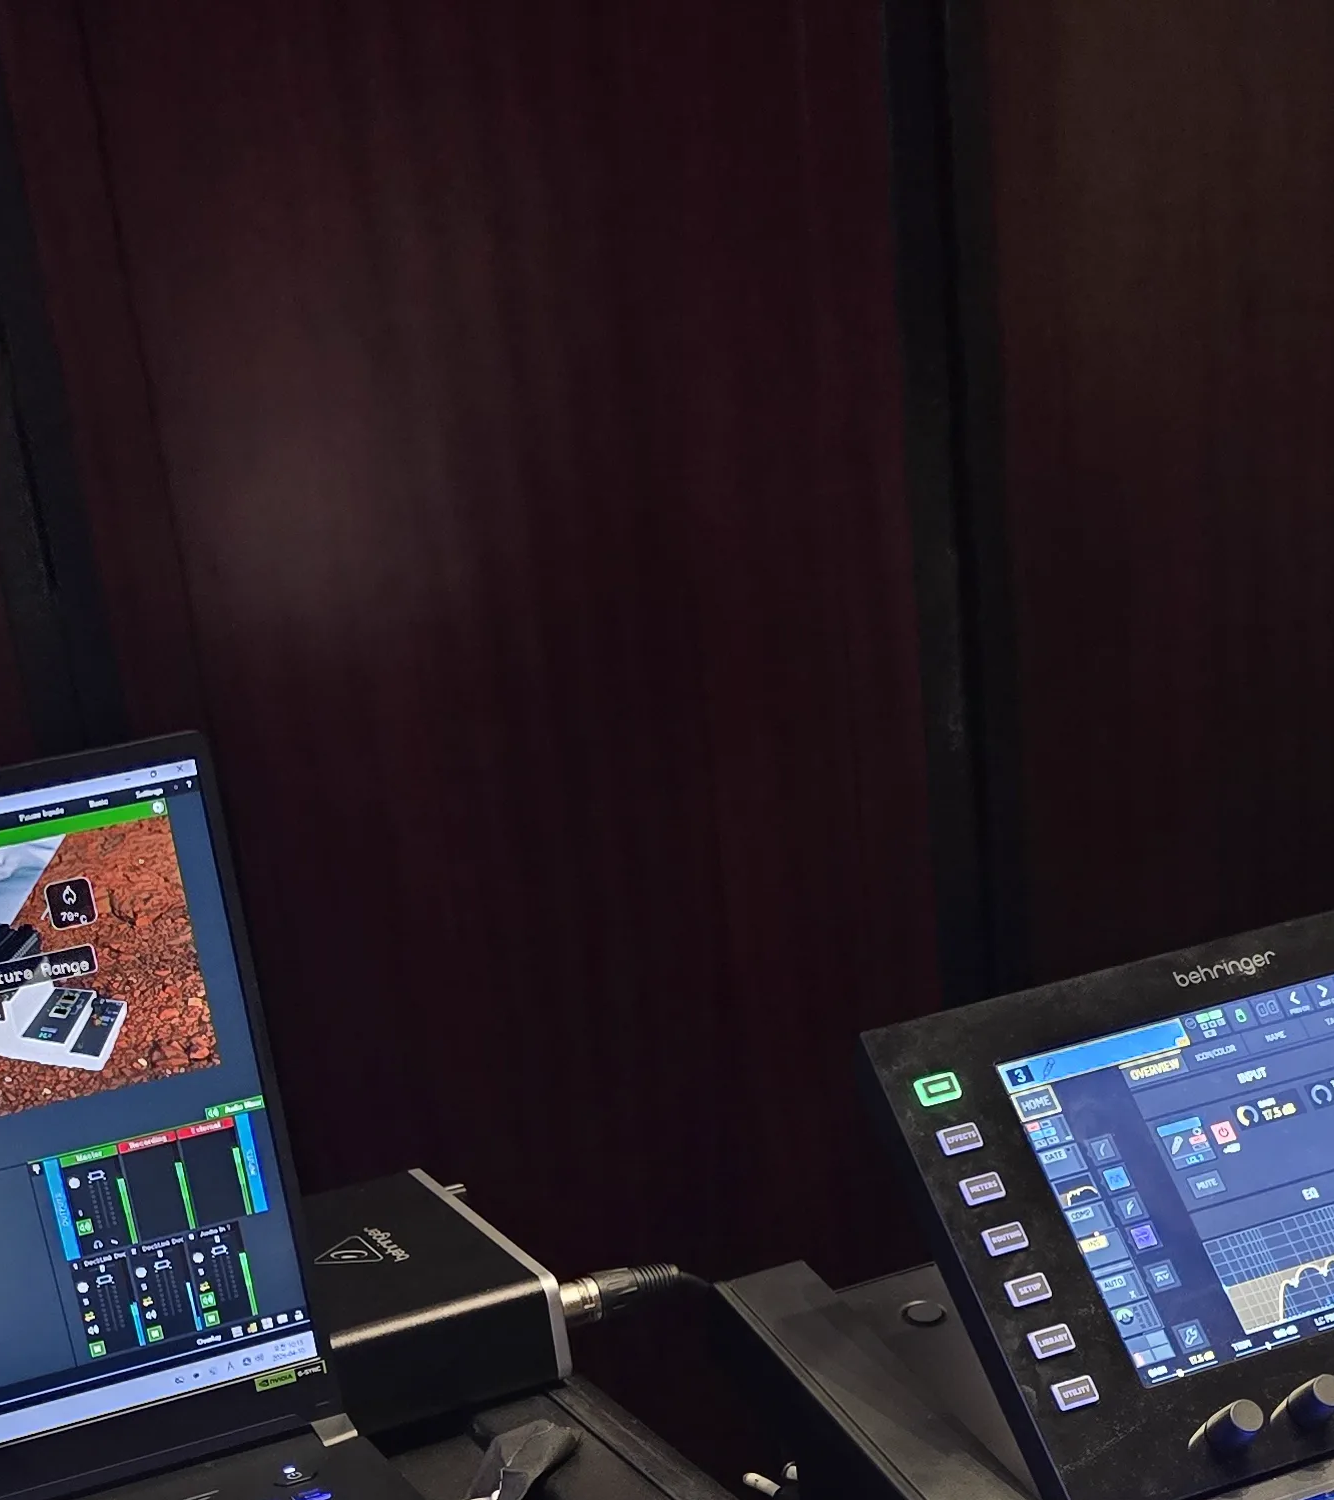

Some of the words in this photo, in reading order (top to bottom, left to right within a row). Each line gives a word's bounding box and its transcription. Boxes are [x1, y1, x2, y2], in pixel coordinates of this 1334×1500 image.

[41, 959, 90, 979] Range
[1172, 950, 1276, 988] behringer
[1265, 1030, 1287, 1042] NAME
[1014, 1069, 1027, 1083] 3
[1129, 1058, 1180, 1081] OVERVIEW
[1236, 1066, 1268, 1084] INPUT
[1021, 1095, 1052, 1112] HOME
[128, 1135, 167, 1149] Recording
[1044, 1150, 1064, 1161] GATE
[969, 1180, 998, 1194] METERS
[1195, 1177, 1218, 1190] MUTE
[1302, 1186, 1320, 1200] EQ
[1018, 1282, 1042, 1296] SETUP
[1103, 1278, 1124, 1289] AUTO
[1038, 1334, 1069, 1348] LIBRARY
[270, 1375, 293, 1384] NVIDIA
[298, 1367, 321, 1377] G-SYNC
[1062, 1385, 1091, 1399] UTILITY
